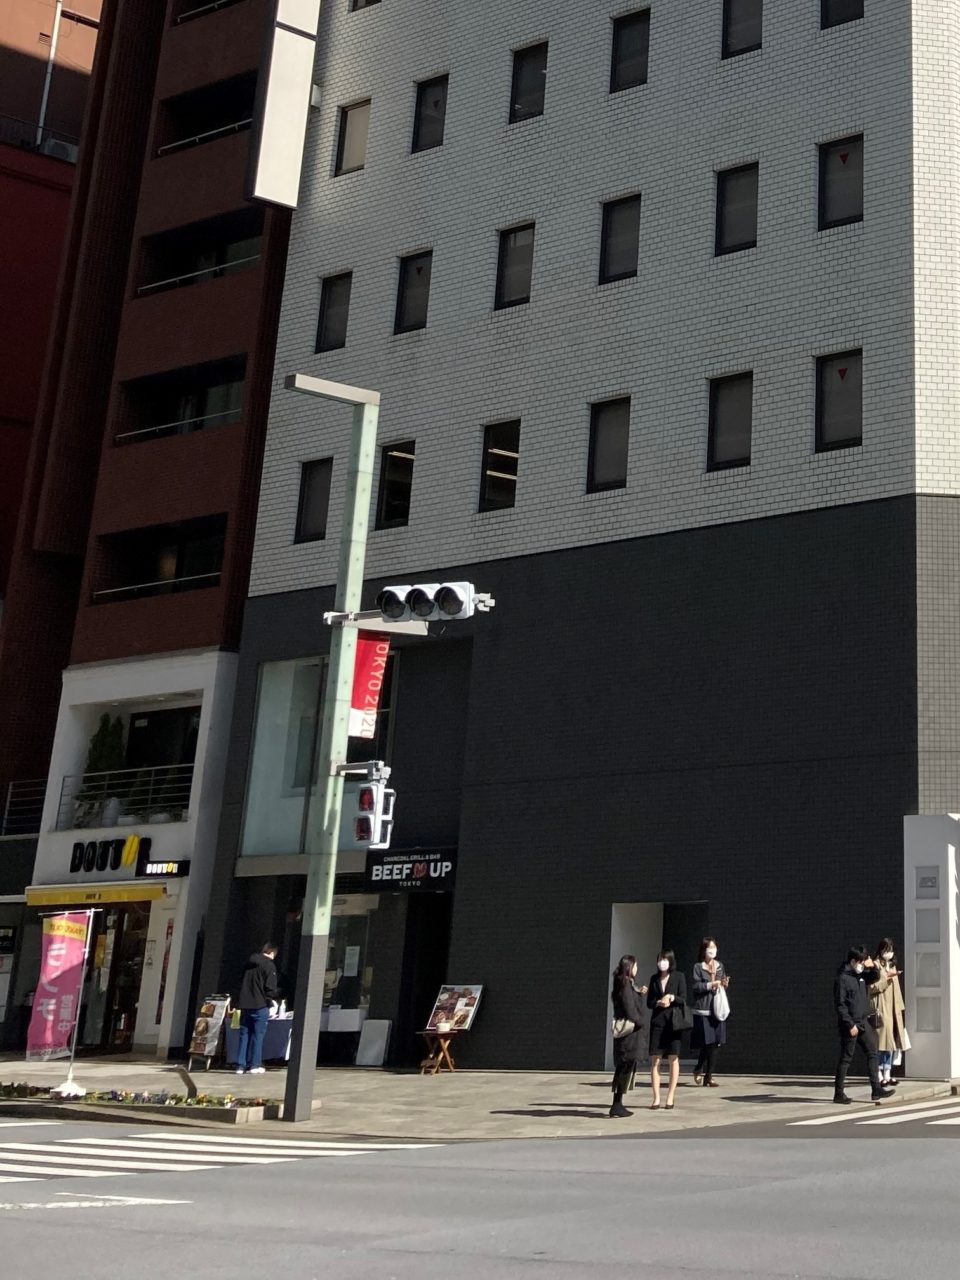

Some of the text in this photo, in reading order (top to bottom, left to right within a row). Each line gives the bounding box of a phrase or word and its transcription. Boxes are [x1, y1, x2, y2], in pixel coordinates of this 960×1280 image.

[360, 694, 379, 738] 2020
[371, 861, 452, 881] BEEF UP
